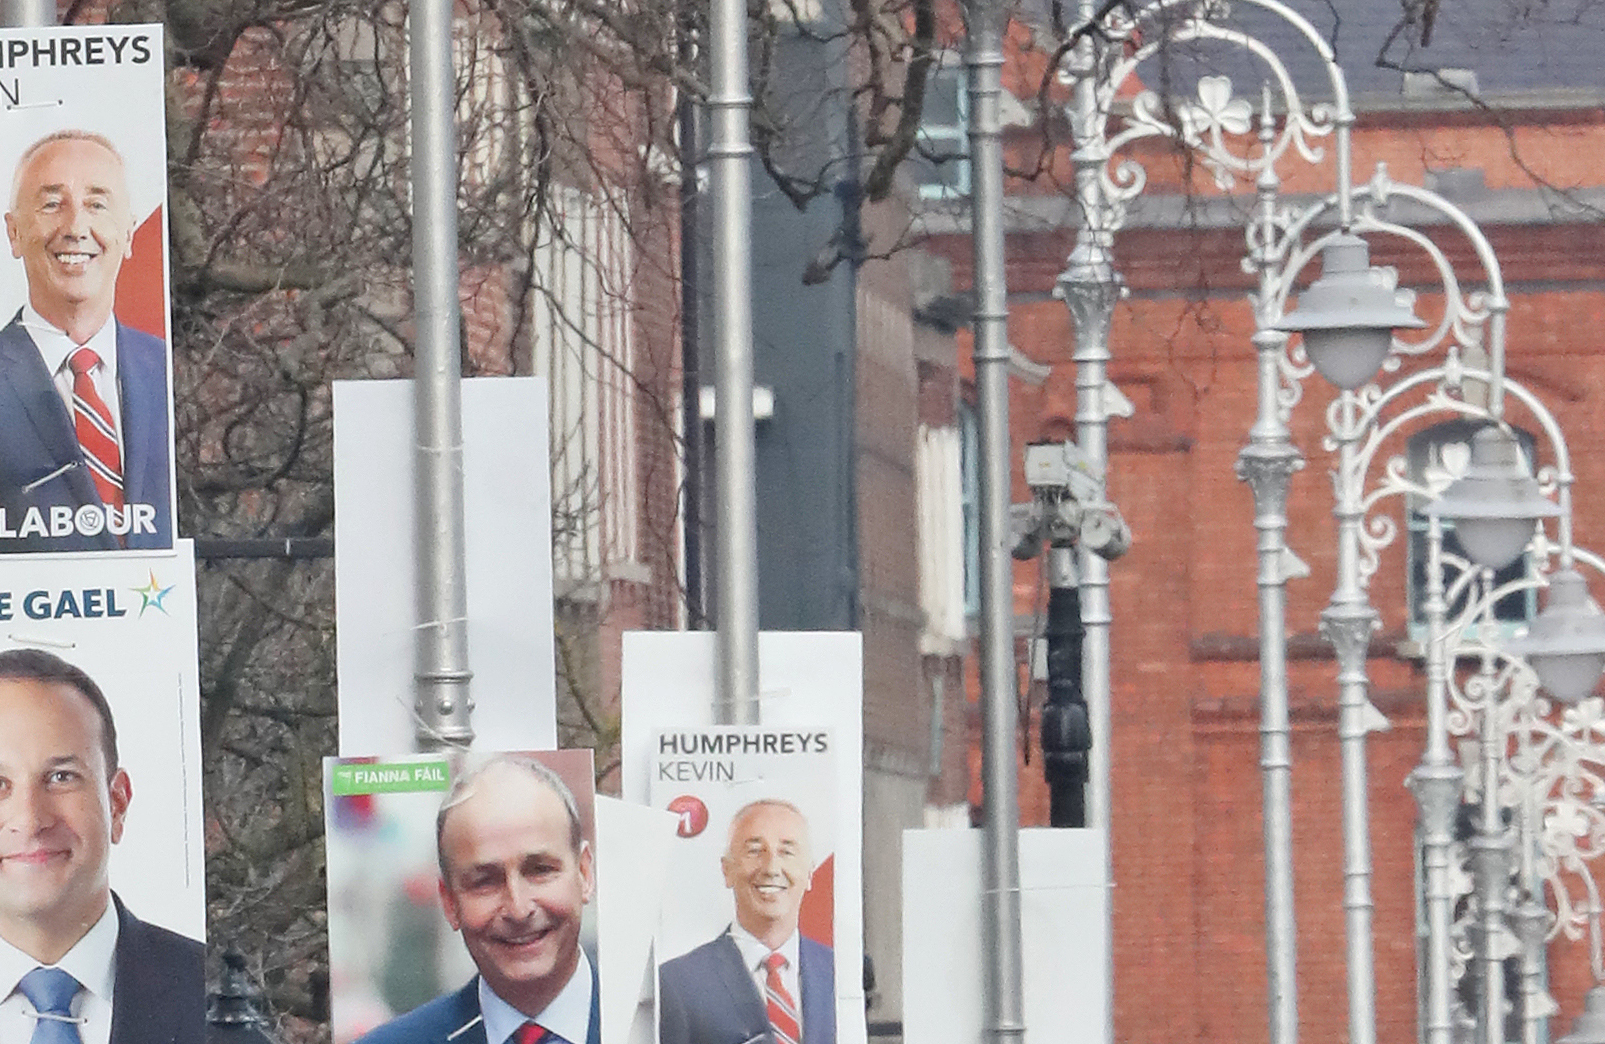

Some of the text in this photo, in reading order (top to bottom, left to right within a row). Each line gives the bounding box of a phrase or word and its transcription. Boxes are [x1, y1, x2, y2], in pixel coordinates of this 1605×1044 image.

[22, 588, 128, 621] GAEL
[659, 733, 829, 754] HUMPHREYS
[354, 769, 411, 784] FIANNA
[658, 760, 735, 782] KEVIN
